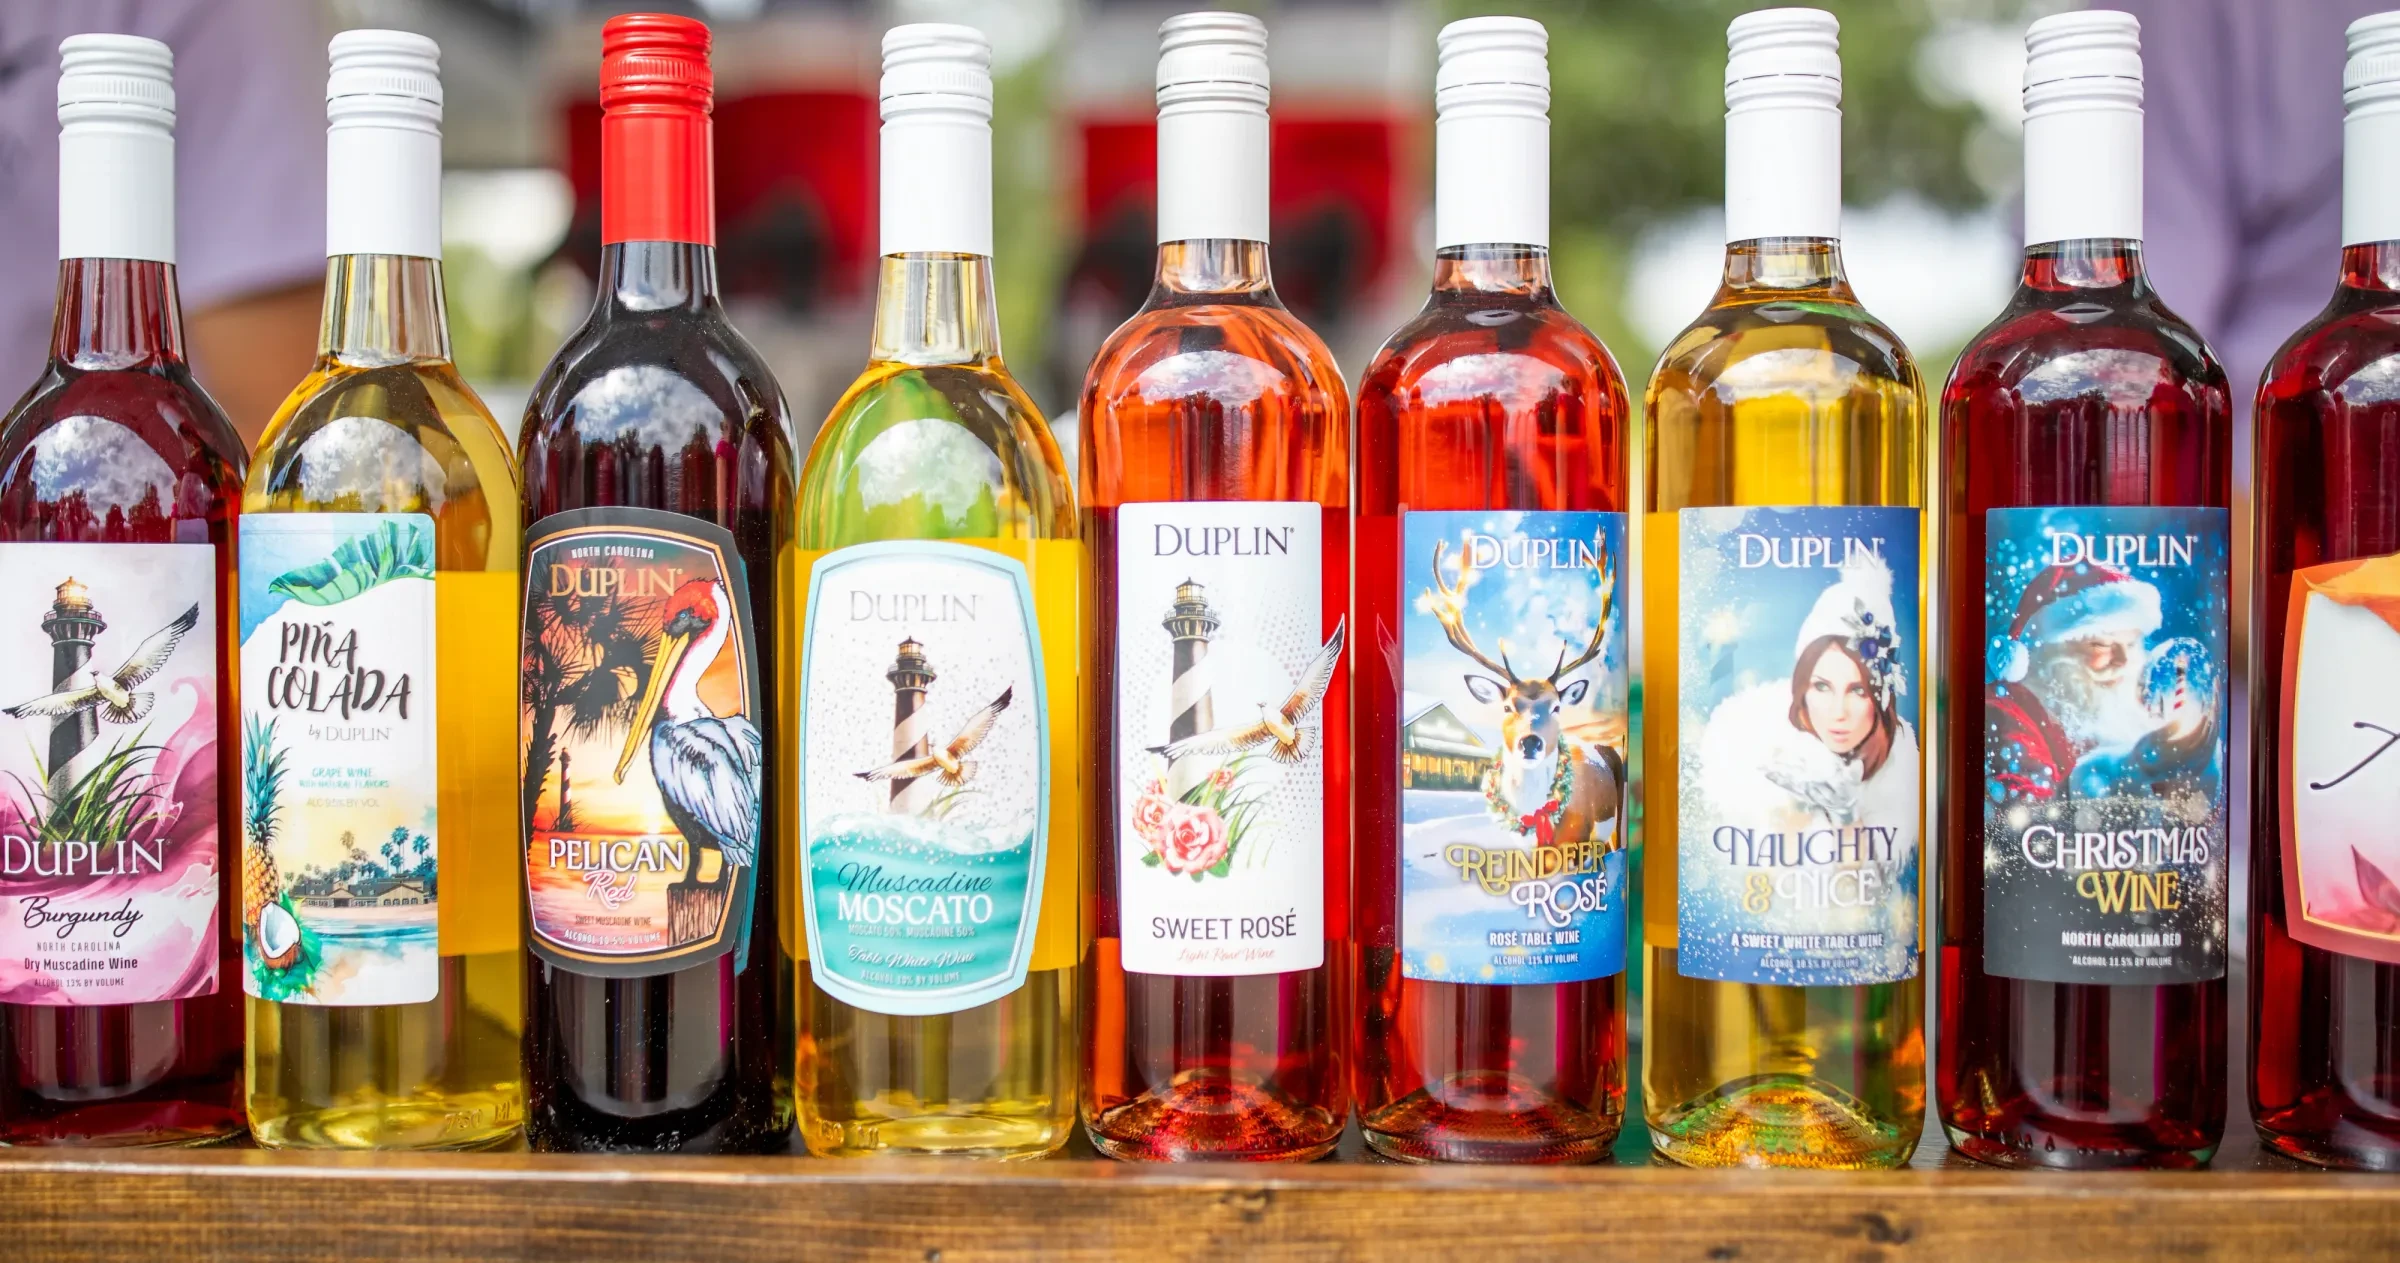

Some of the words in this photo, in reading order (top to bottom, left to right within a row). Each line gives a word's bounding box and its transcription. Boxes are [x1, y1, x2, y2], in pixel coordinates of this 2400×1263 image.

[571, 546, 600, 559] NORTH
[604, 546, 654, 559] CAROLINA
[268, 666, 411, 720] COLADA
[308, 724, 321, 740] by
[312, 767, 341, 777] GRAPE
[347, 767, 374, 777] WINE
[1713, 825, 1898, 867] NAUGHTY
[2021, 825, 2209, 870] CHRISTMAS
[549, 838, 685, 872] PELICAN
[1445, 841, 1607, 896] REINDEER
[837, 862, 994, 893] Muscadine
[583, 870, 636, 910] Red
[1743, 873, 1773, 914] &
[1774, 869, 1877, 910] NICE
[2076, 870, 2181, 914] WINE
[838, 892, 993, 925] MOSCATO
[1511, 872, 1608, 928] ROSÉ
[19, 896, 143, 939] Burgundy
[1152, 916, 1232, 940] SWEET
[1240, 907, 1297, 939] ROSÉ
[564, 929, 596, 944] ALCOHOL
[848, 924, 882, 936] MOSCATO
[907, 926, 954, 938] MUSCADINE
[956, 926, 975, 937] 50%
[1490, 931, 1517, 946] ROSÉ
[1521, 932, 1552, 945] TABLE
[1555, 930, 1580, 945] WINE
[2061, 931, 2101, 947] NORTH
[2104, 932, 2160, 948] CAROLINA
[2162, 932, 2182, 948] RED
[37, 941, 65, 952] NORTH
[71, 941, 121, 952] CAROLINA
[1731, 933, 1740, 947] A
[1741, 934, 1780, 948] SWEET
[1783, 935, 1821, 949] WHITE
[1824, 935, 1856, 948] TABLE
[1858, 933, 1884, 947] WINE
[24, 958, 40, 972] Dry
[44, 957, 105, 970] Muscadine
[109, 957, 138, 970] Wine
[886, 952, 932, 968] White
[934, 951, 976, 968] Wine
[1494, 954, 1525, 965] ALCOHOL
[1528, 955, 1542, 965] 11%
[1545, 954, 1553, 964] BY
[1555, 953, 1578, 963] VOLUME
[1760, 957, 1794, 969] ALCOHOL
[2072, 956, 2107, 967] ALCOHOL
[2135, 956, 2144, 967] BY
[2145, 956, 2172, 968] VOLUME
[34, 979, 63, 988] ALCOHOL
[84, 979, 93, 987] BY
[95, 977, 125, 987] VOLUME
